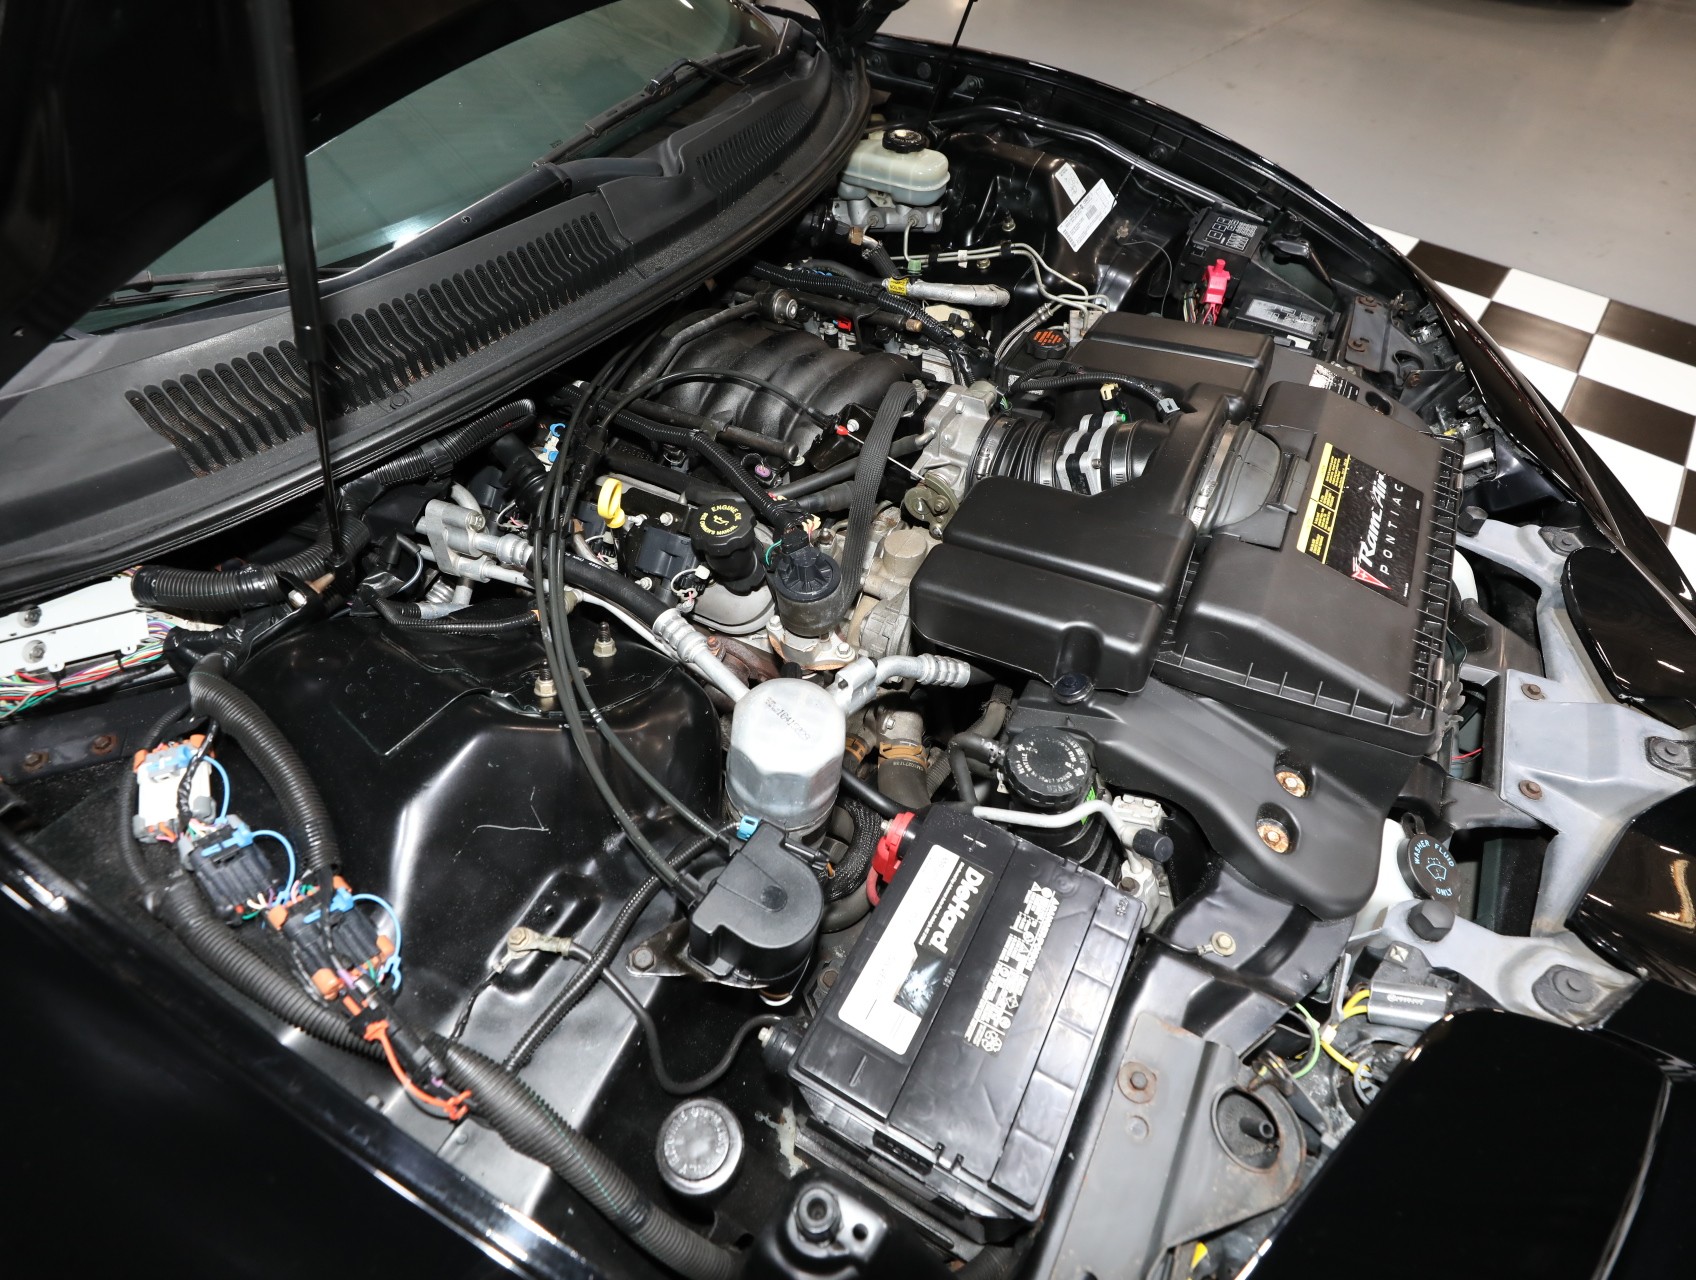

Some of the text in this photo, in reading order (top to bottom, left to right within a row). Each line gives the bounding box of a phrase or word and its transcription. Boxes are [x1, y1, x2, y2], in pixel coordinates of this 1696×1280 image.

[710, 504, 738, 513] ENGINE
[715, 524, 738, 535] MANUAL
[1379, 483, 1404, 576] PONTIAC
[1413, 839, 1455, 867] WASHER FLUID
[1435, 887, 1453, 897] ONLY
[928, 865, 985, 954] DieHard
